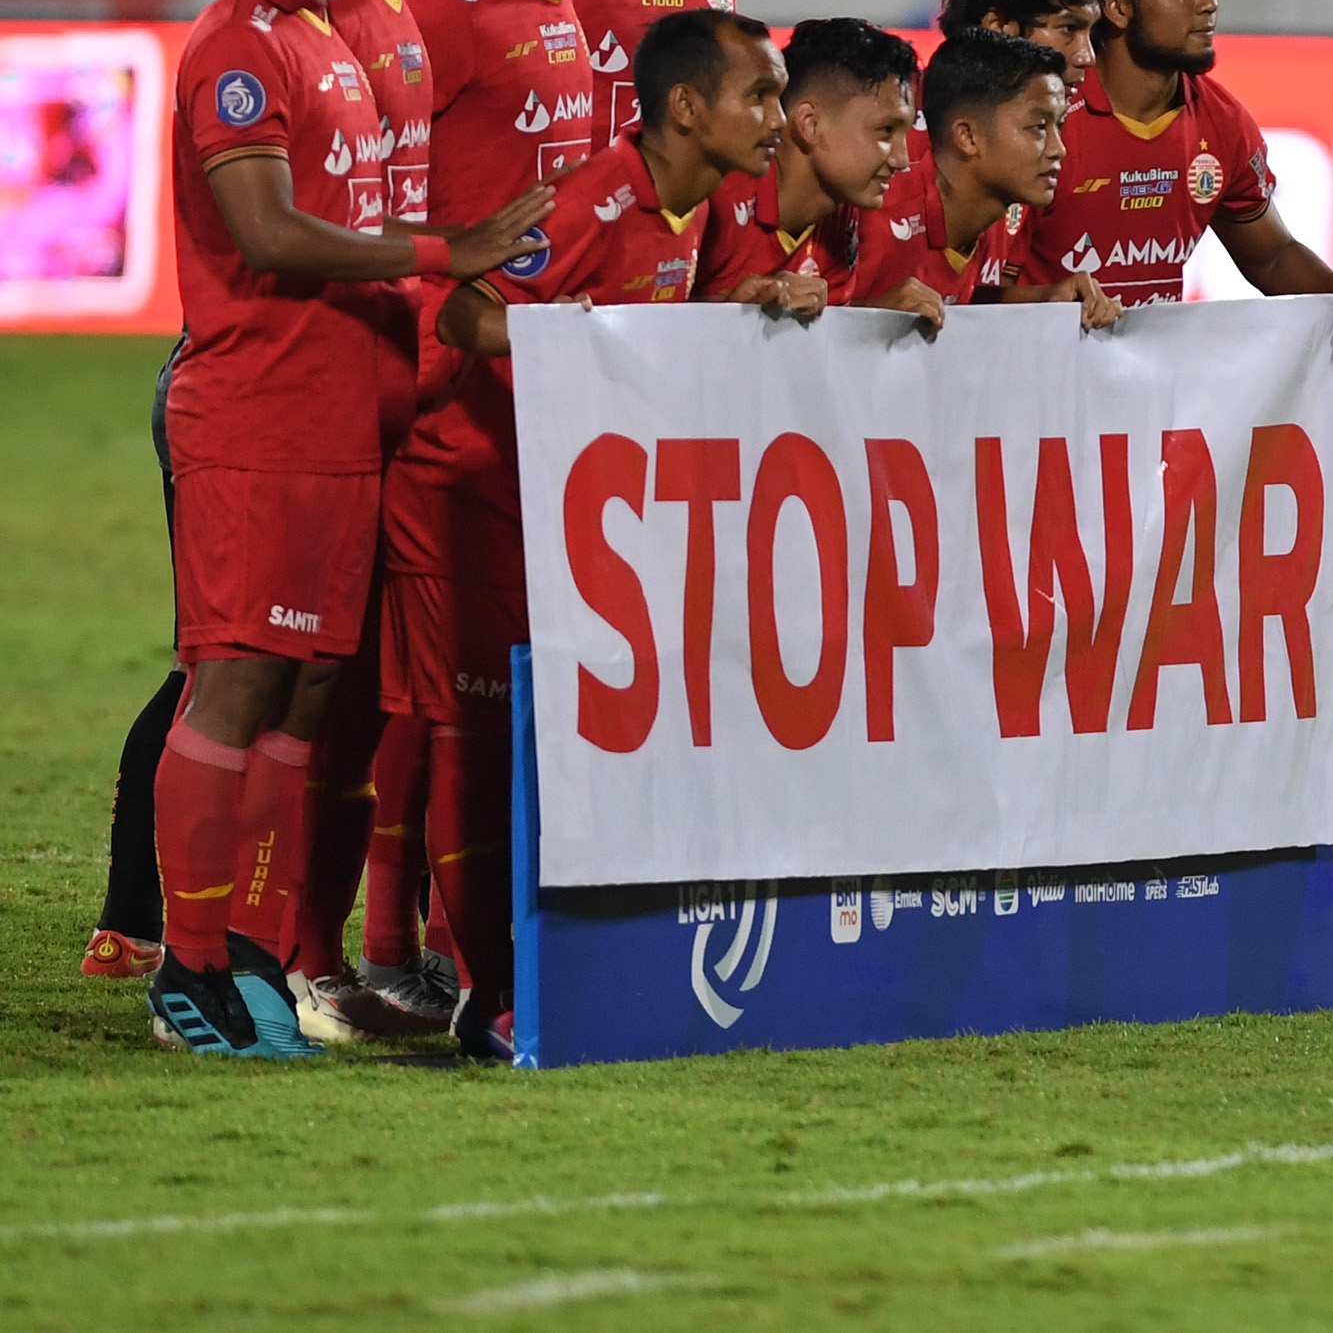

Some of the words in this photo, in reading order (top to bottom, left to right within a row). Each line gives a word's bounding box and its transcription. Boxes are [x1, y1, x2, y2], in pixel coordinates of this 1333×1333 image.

[1120, 168, 1178, 184] KukuBima
[1120, 196, 1164, 210] C1000
[563, 432, 939, 753] STOP
[975, 423, 1324, 738] WAR
[456, 672, 512, 700] SAM
[245, 830, 276, 907] JUARA
[836, 881, 858, 906] BRI
[895, 889, 922, 909] Emtek
[931, 875, 977, 917] SCM
[1028, 871, 1066, 908] Vidio
[1145, 882, 1168, 901] SPECS
[678, 884, 725, 924] LIGA
[840, 910, 857, 926] mo
